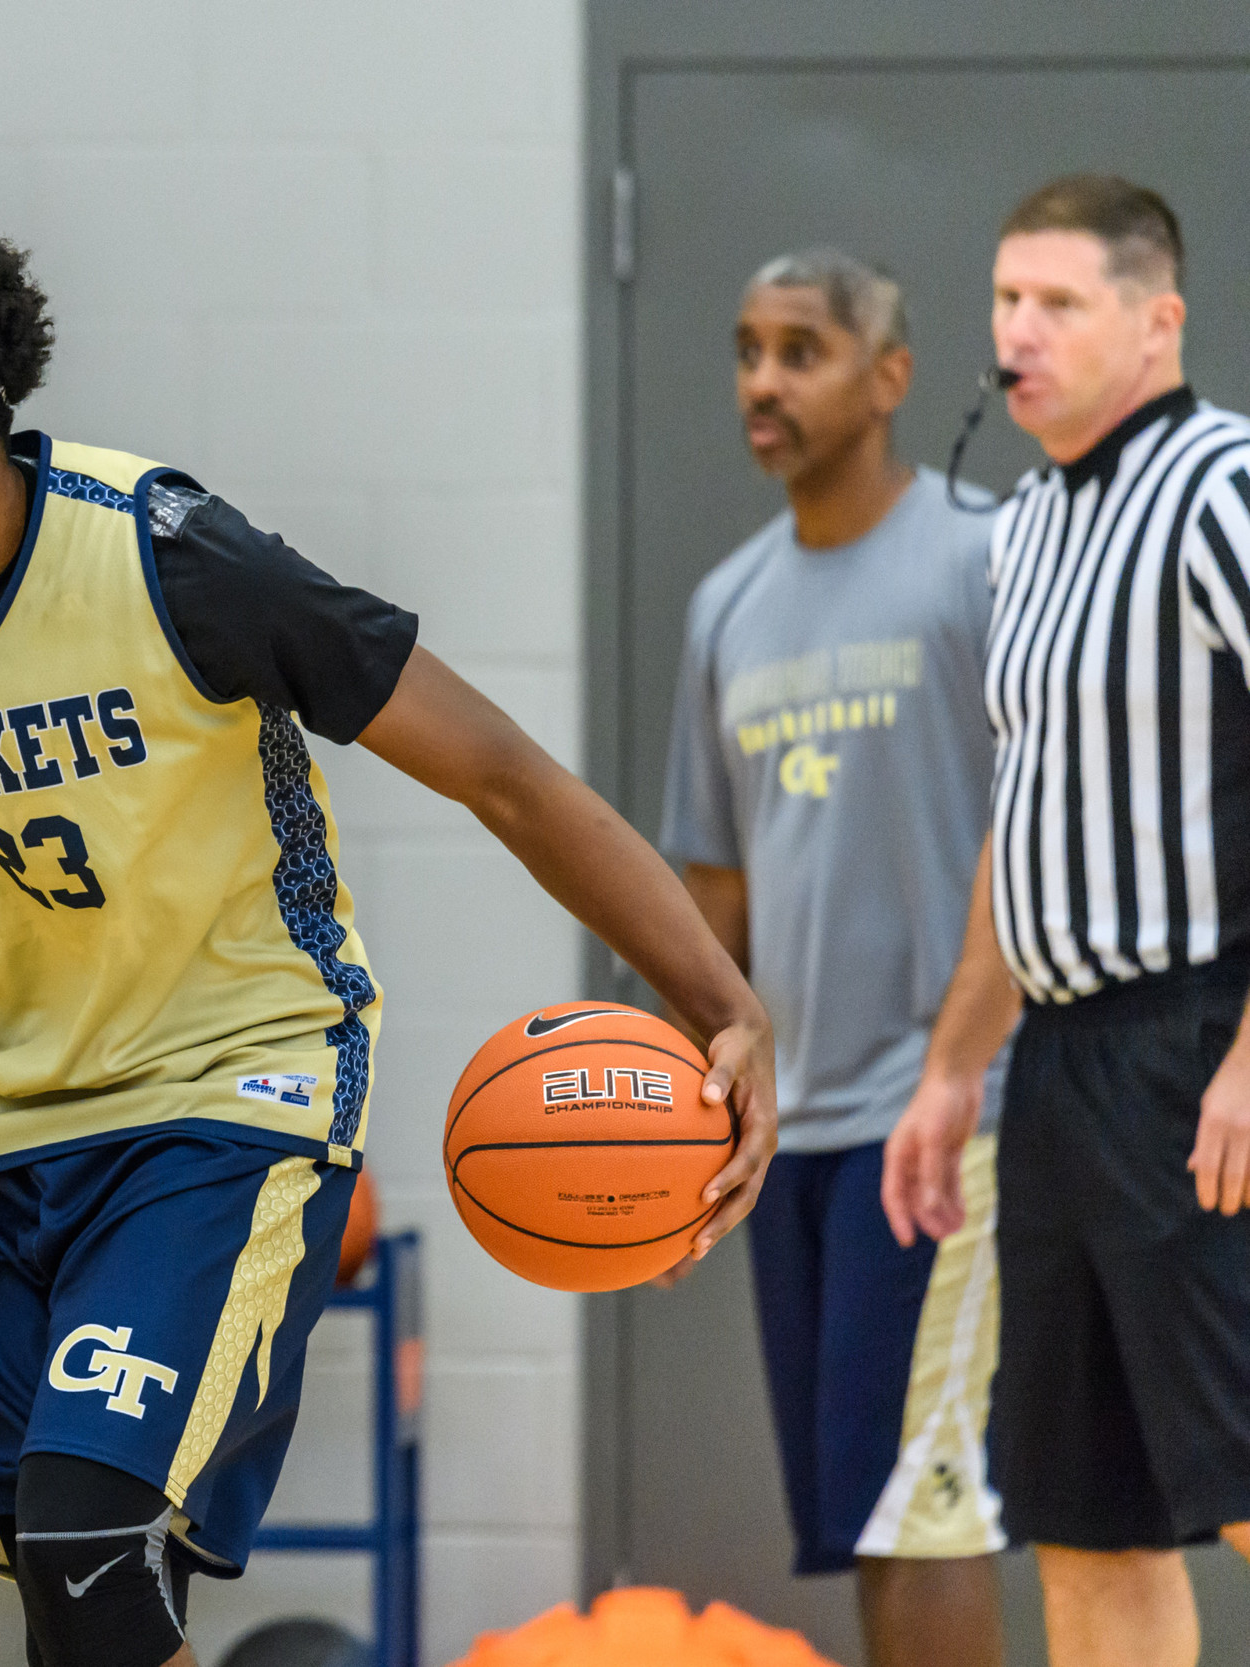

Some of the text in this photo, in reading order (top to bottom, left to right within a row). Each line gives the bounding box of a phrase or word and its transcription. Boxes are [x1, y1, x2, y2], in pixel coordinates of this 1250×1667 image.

[242, 1082, 276, 1092] RUSSELL
[295, 1083, 304, 1093] L
[542, 1067, 673, 1105] ELITE
[544, 1101, 673, 1115] CHAMPIONSHIP
[48, 1323, 179, 1420] GT
